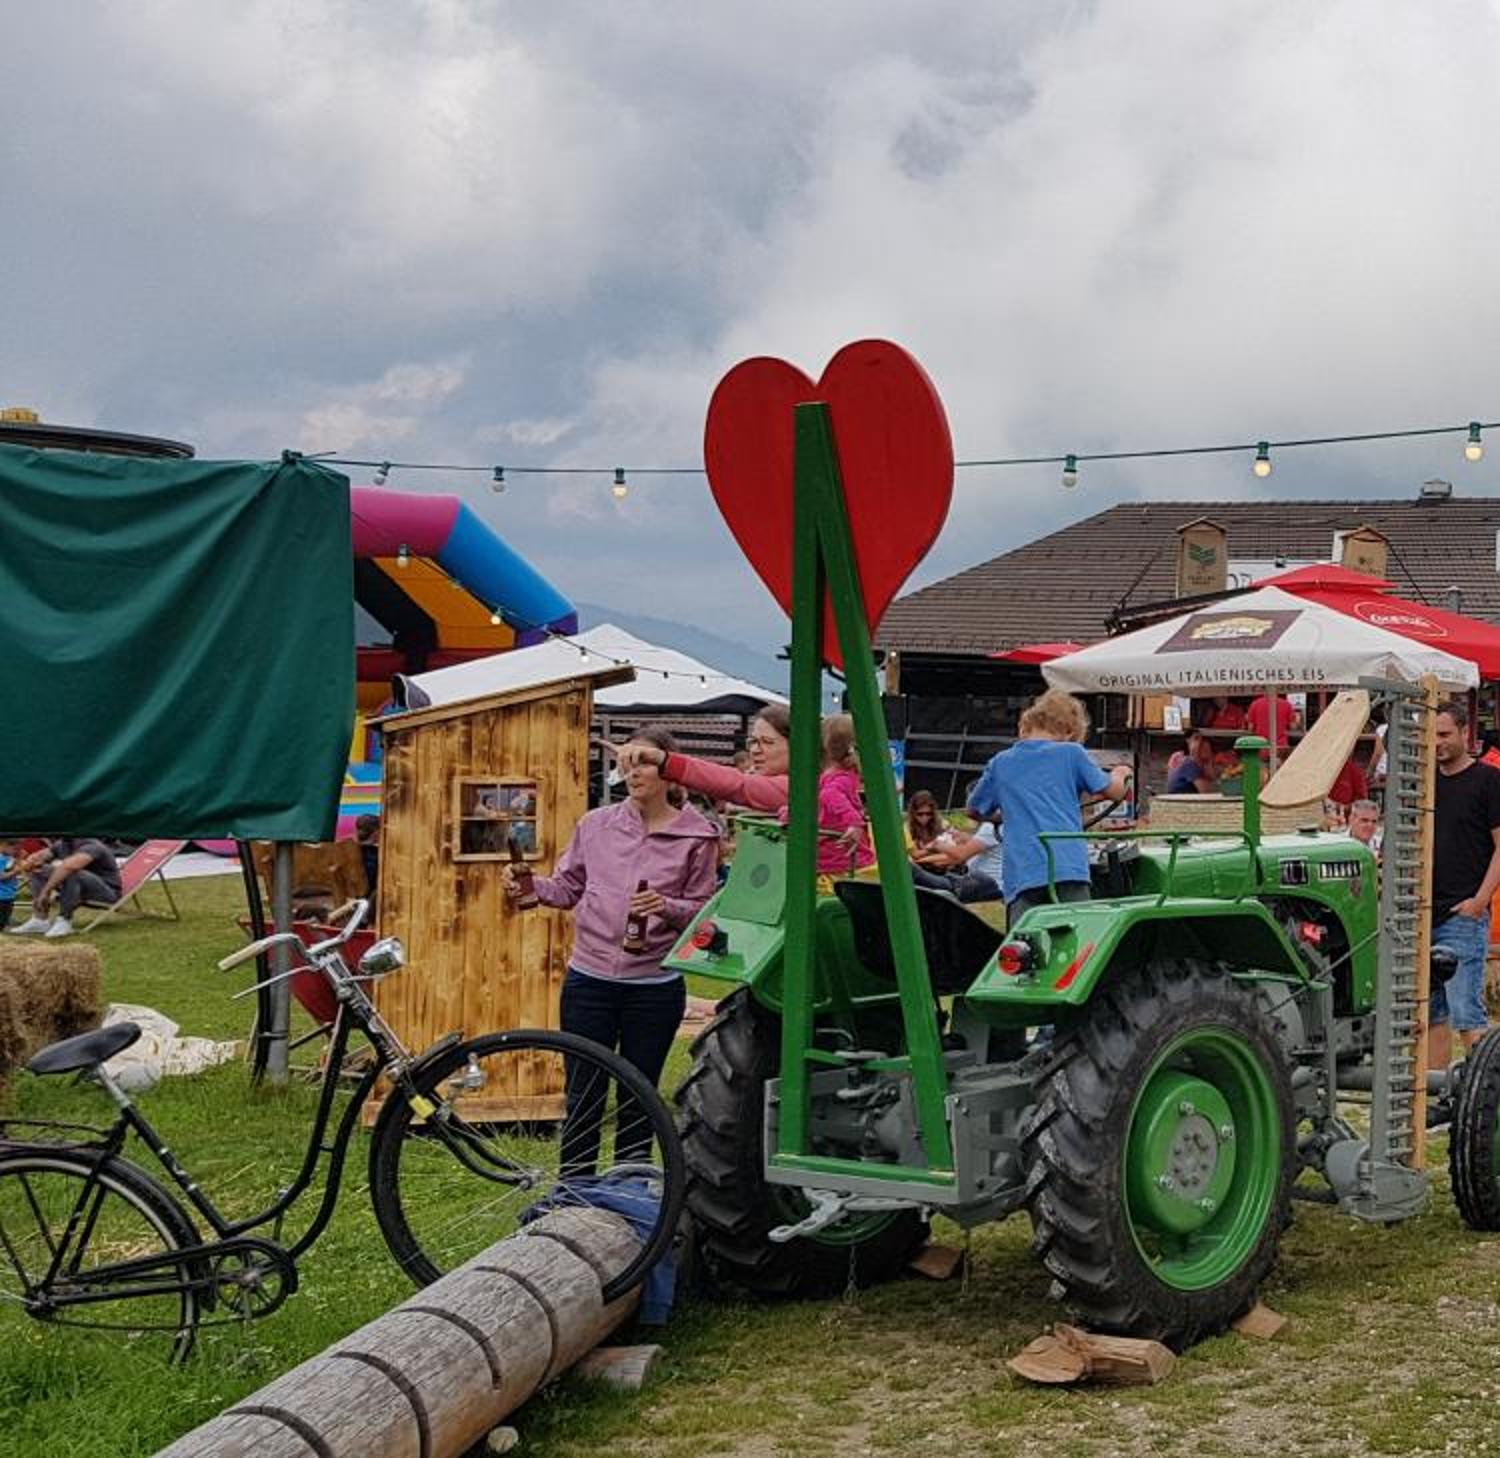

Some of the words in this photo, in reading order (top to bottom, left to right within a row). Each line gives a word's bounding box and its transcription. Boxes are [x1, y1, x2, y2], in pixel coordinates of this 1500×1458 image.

[1099, 671, 1172, 687] ORIGINAL
[1178, 668, 1296, 682] ITALIENISCHES
[1302, 668, 1326, 681] EIS
